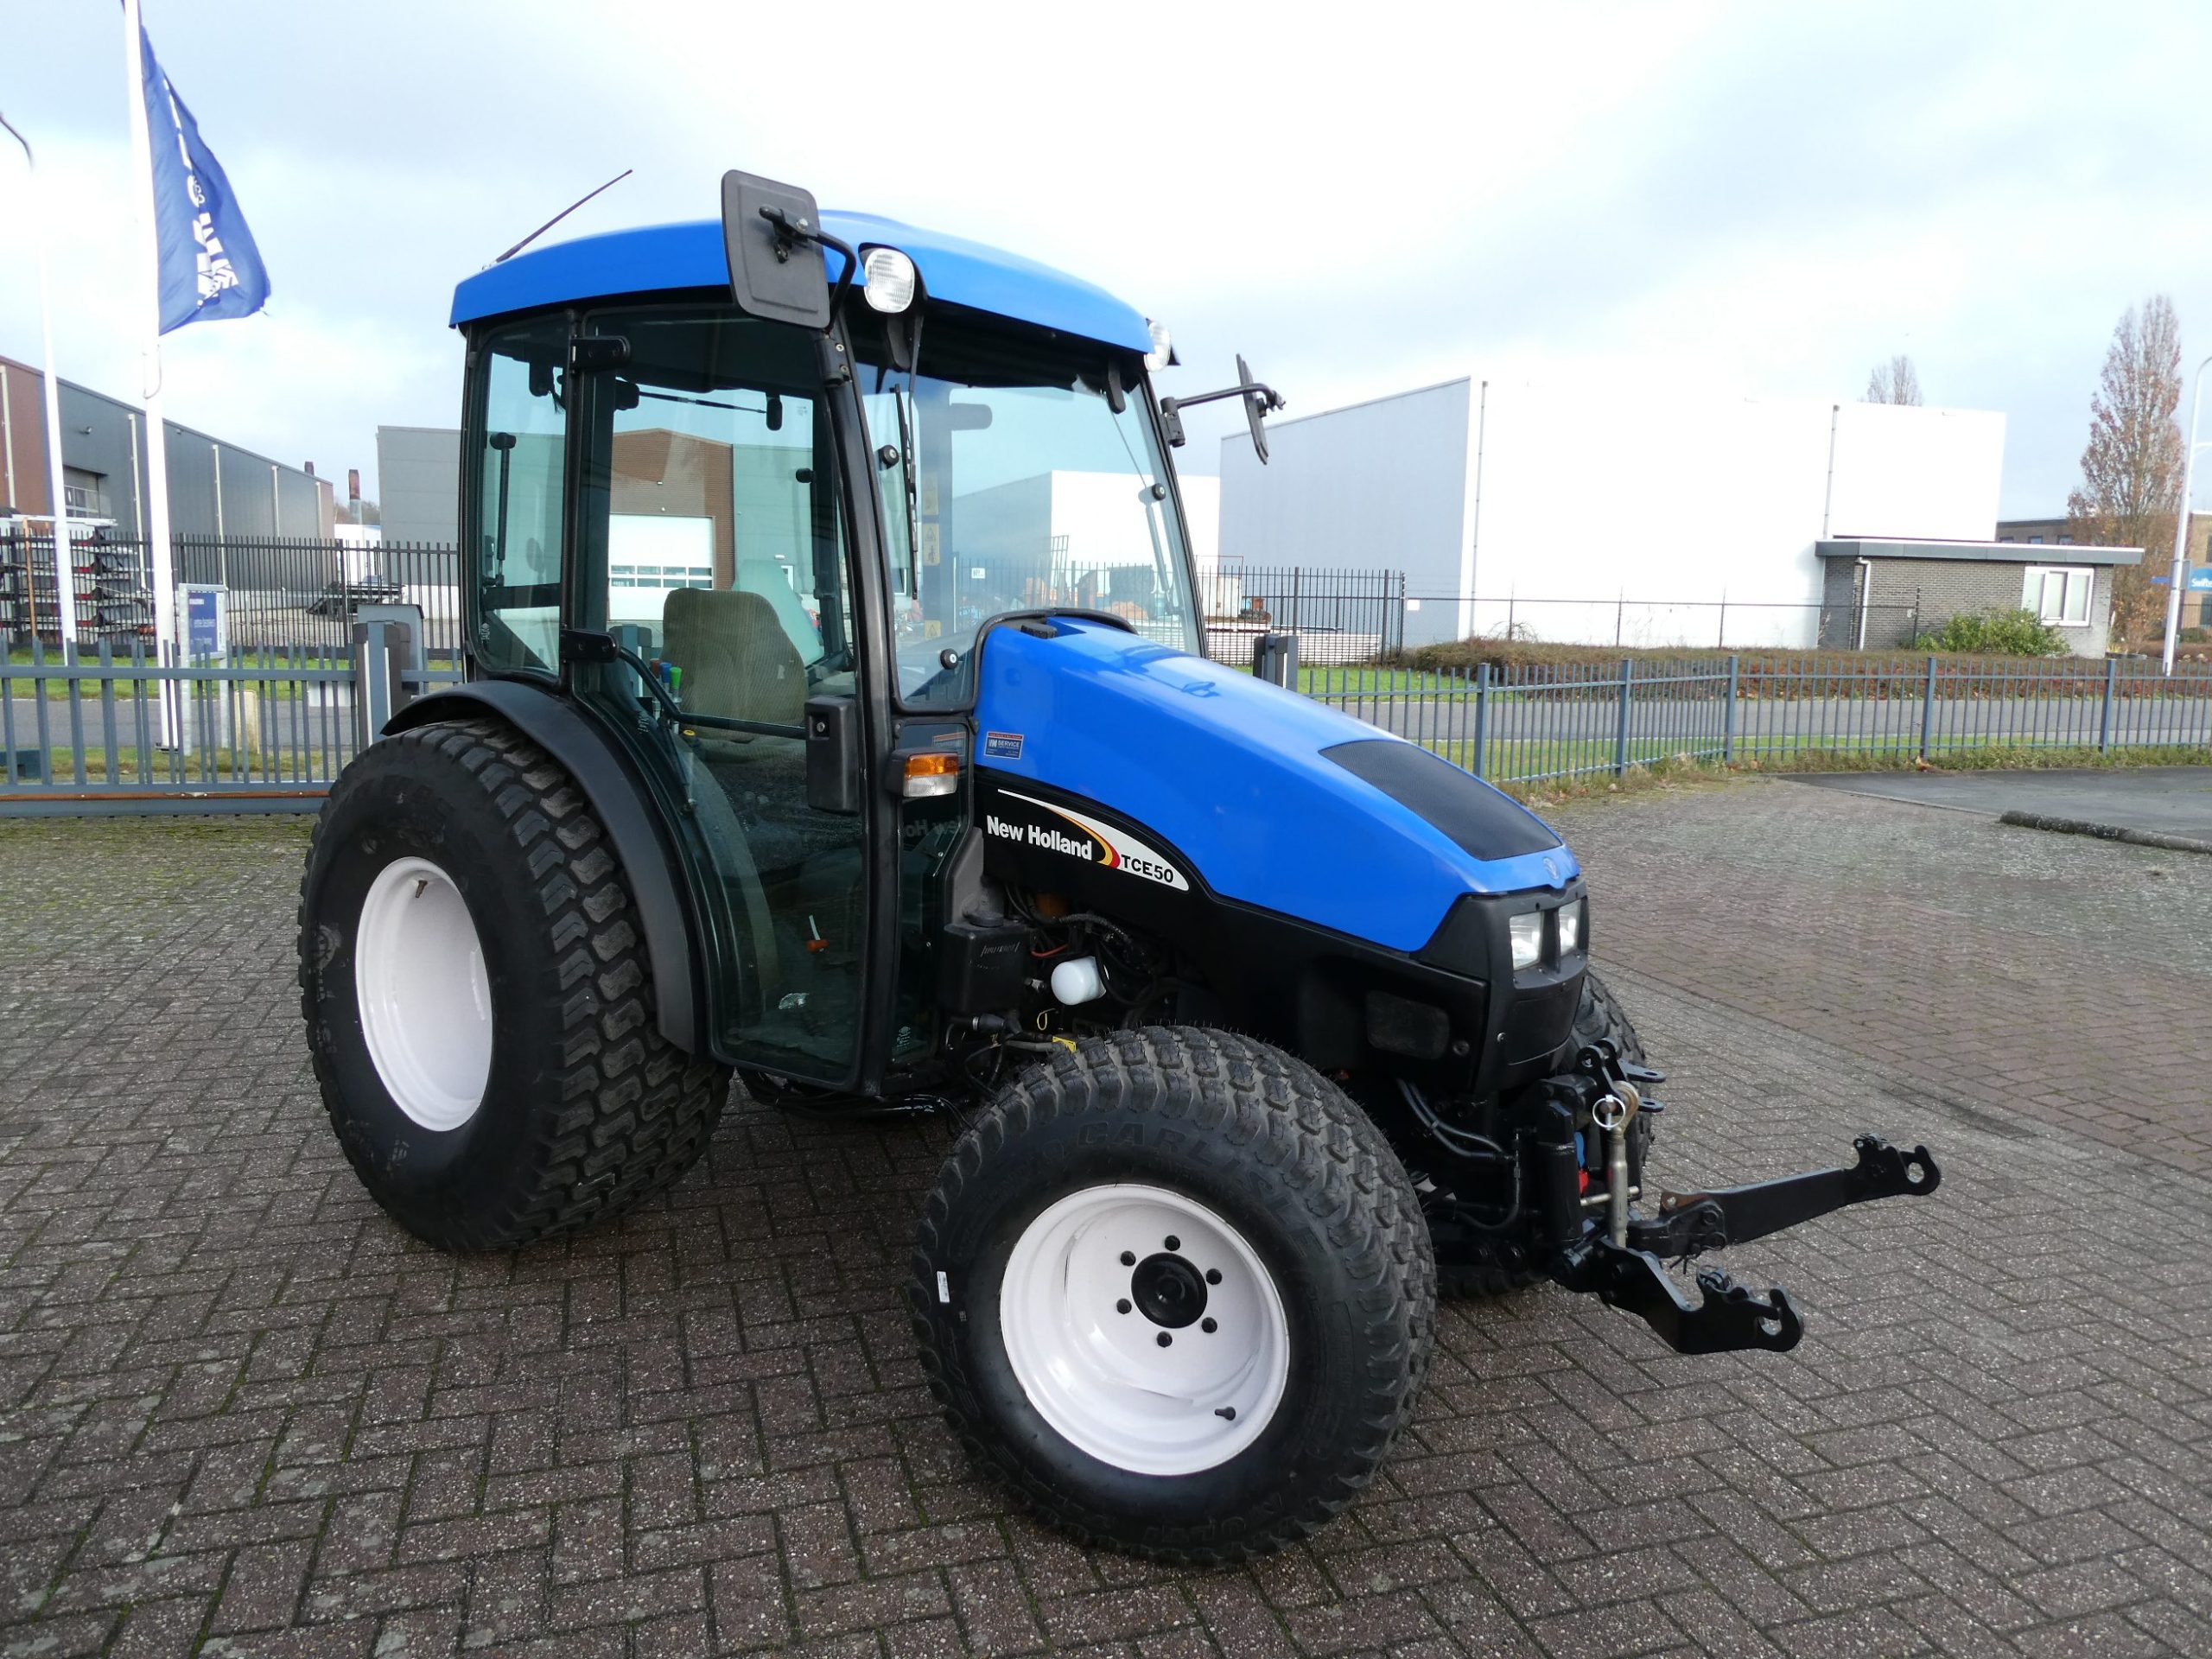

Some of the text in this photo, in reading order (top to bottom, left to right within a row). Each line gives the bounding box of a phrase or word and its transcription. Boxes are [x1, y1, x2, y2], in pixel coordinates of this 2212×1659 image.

[987, 815, 1092, 861] New Holland
[1121, 854, 1173, 883] TCE50
